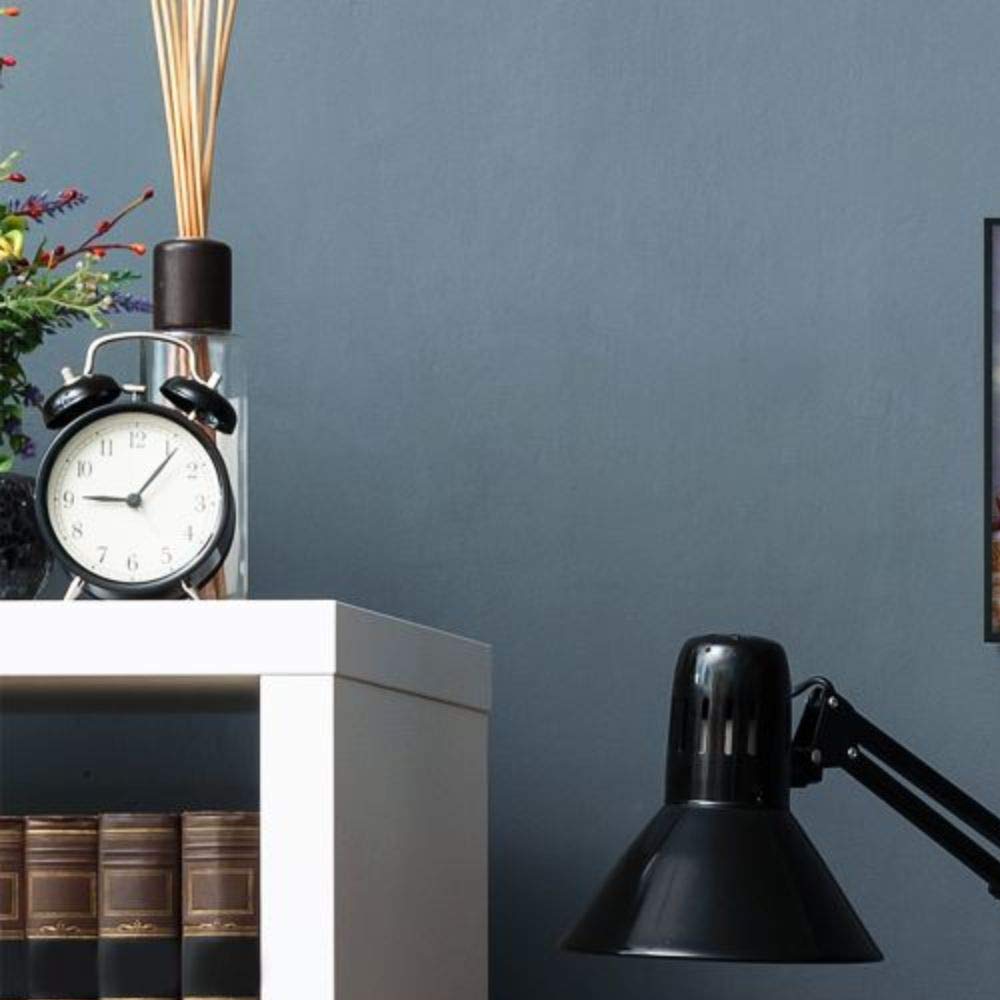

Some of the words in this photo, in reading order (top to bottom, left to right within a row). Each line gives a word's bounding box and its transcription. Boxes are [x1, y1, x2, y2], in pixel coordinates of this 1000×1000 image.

[101, 439, 113, 457] 11
[129, 430, 146, 449] 12
[77, 460, 93, 478] 10
[187, 461, 199, 479] 2
[63, 490, 75, 509] 9
[194, 495, 207, 512] 3
[71, 521, 84, 539] 8
[185, 525, 195, 541] 4
[97, 545, 109, 563] 7
[127, 553, 140, 572] 6
[161, 546, 173, 565] 5
